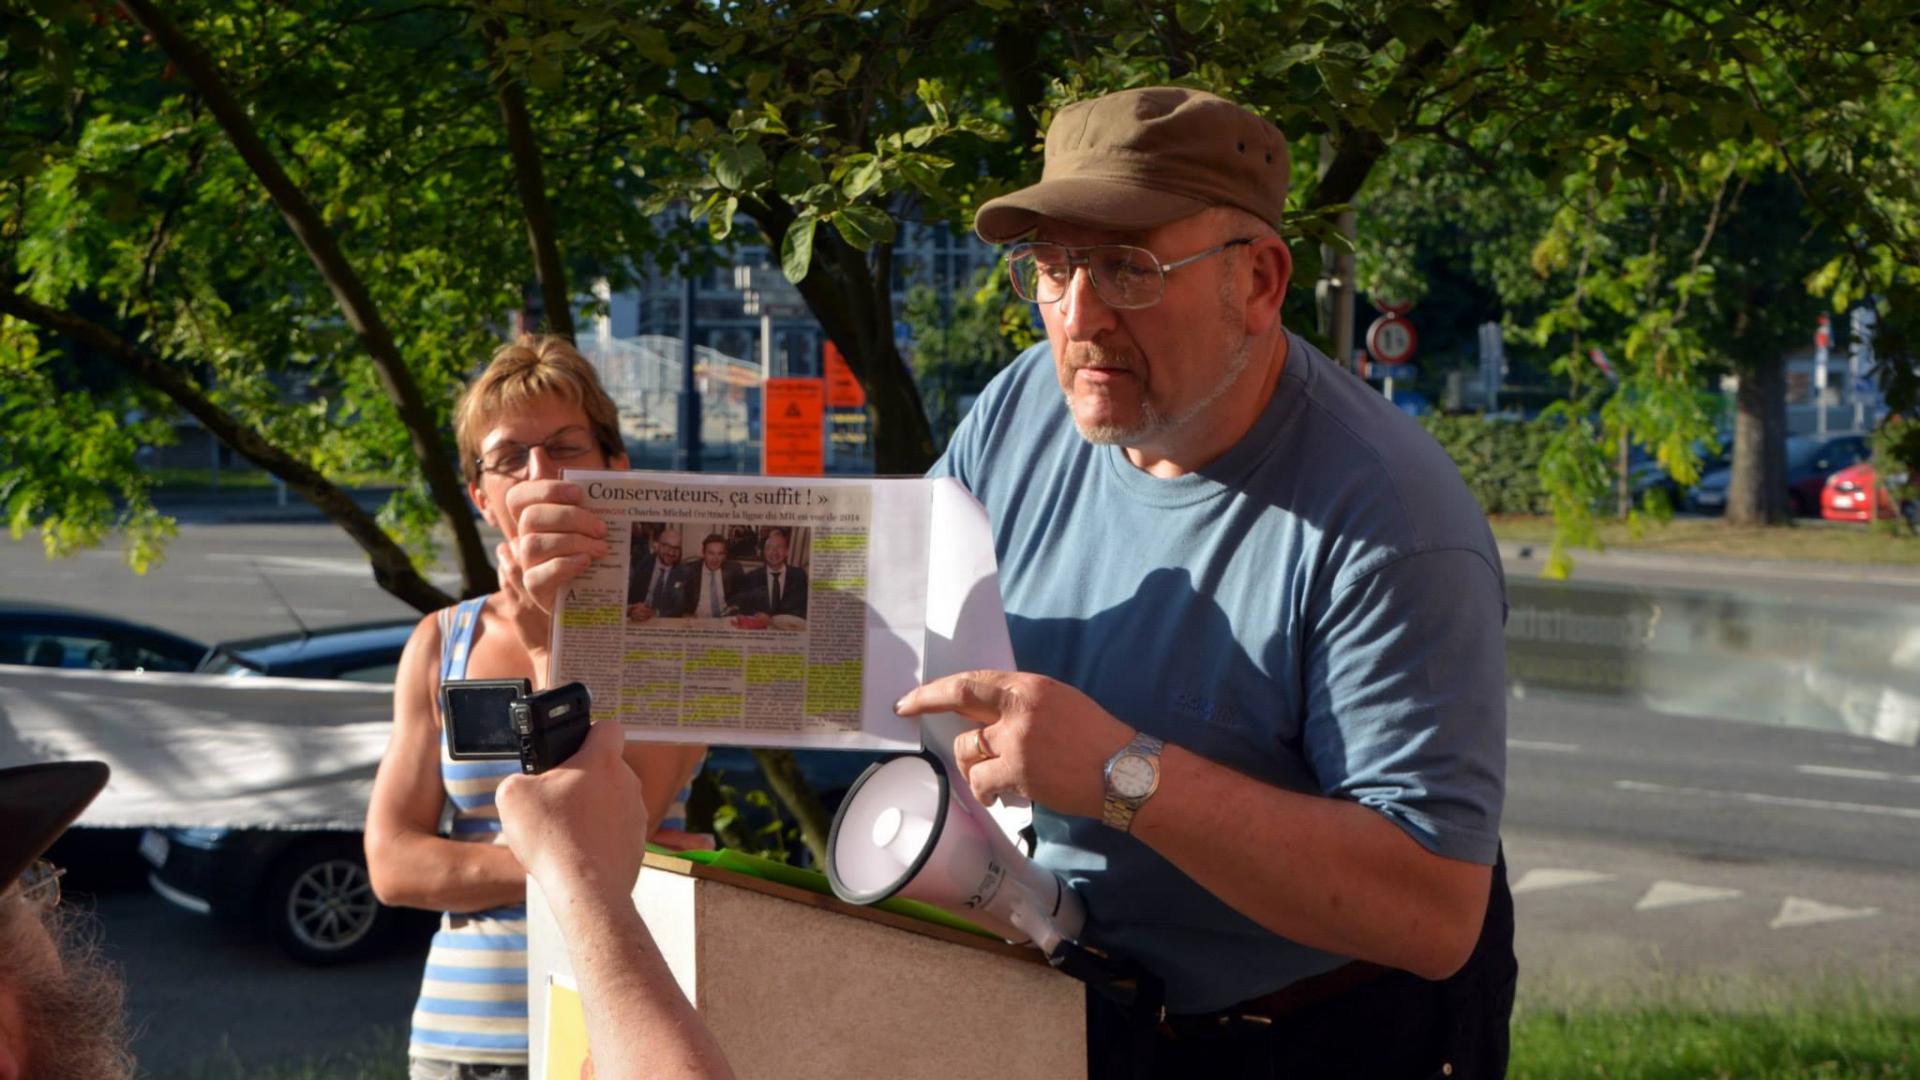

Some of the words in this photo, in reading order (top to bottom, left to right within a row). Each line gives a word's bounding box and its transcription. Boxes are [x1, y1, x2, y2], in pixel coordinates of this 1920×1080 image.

[588, 482, 724, 505] Conservateurs,
[729, 491, 749, 507] ça
[754, 487, 802, 505] suffit
[807, 488, 812, 505] !
[818, 495, 829, 504] »
[627, 506, 660, 518] Charles
[662, 508, 692, 519] Michel
[764, 511, 777, 521] du
[779, 511, 796, 521] MR
